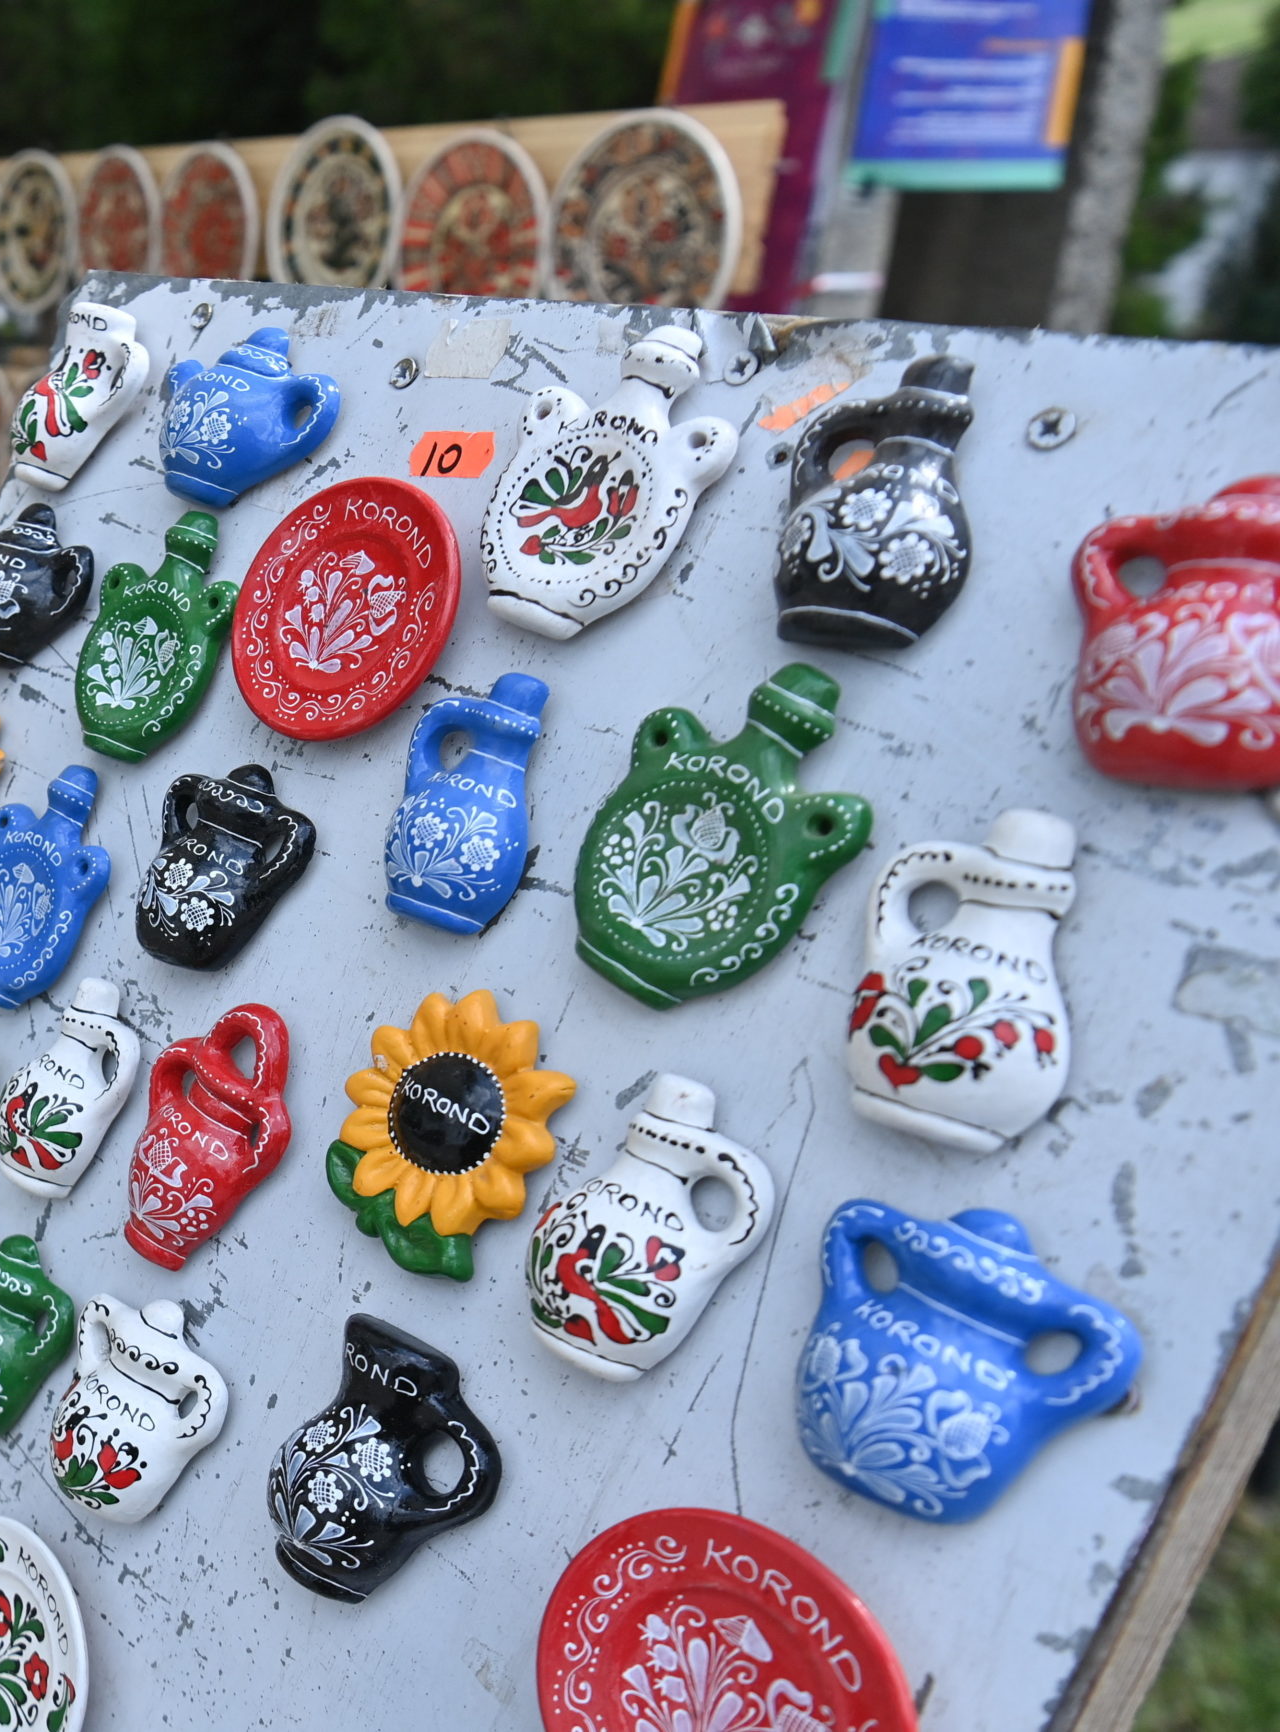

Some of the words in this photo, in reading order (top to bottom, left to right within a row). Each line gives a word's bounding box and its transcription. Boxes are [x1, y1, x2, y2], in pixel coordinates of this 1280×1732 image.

[420, 441, 462, 476] 10
[344, 498, 432, 569] KOROND
[121, 580, 190, 613] KOROND
[664, 752, 783, 824] KOROND
[4, 830, 62, 866] KOROND
[910, 932, 1048, 983] KOROND
[159, 1103, 229, 1161] KOROND
[402, 1076, 490, 1135] KOROND
[345, 1342, 418, 1397] ROND
[855, 1299, 1010, 1392] KOROND
[85, 1370, 156, 1432] KOROND
[16, 1545, 69, 1656] KOROND
[703, 1538, 861, 1692] KOROND
